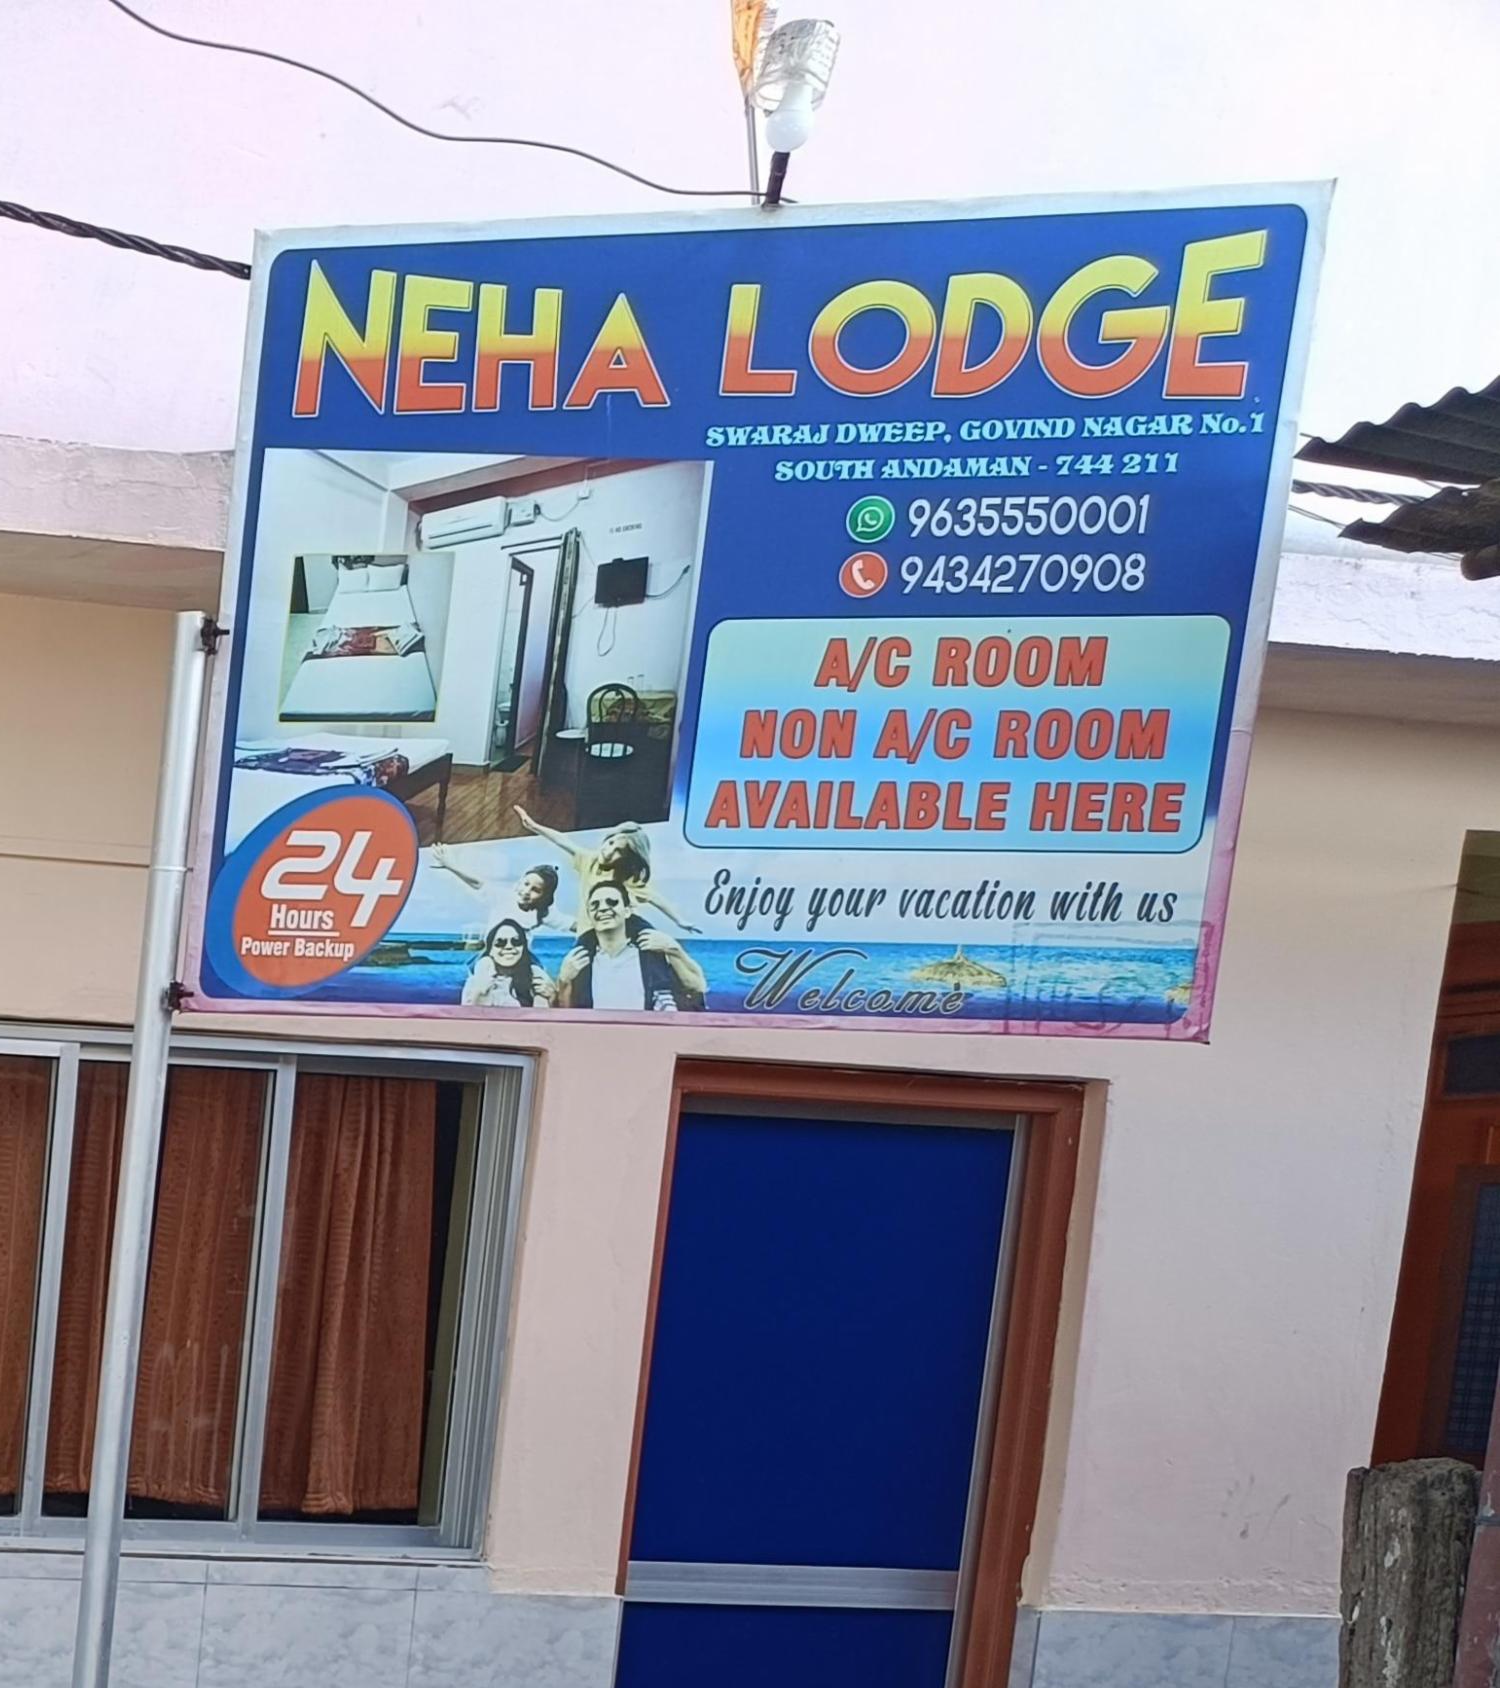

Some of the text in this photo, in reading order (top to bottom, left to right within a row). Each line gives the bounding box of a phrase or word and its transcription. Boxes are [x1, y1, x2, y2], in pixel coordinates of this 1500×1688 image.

[291, 229, 1268, 418] NEHA LODGE
[705, 411, 1266, 449] SWARAJ DWEEP, GOVIND NAGAR No.1
[773, 458, 875, 482] SOUTH
[880, 456, 1033, 479] ANDAMAN
[1056, 453, 1114, 476] 744
[1120, 451, 1180, 475] 211
[906, 493, 1151, 538] 9635550001
[899, 552, 1147, 596] 9434270908
[814, 636, 1109, 693] A/C ROOM
[739, 707, 1171, 764] NON A/C ROOM
[703, 780, 1186, 833] AVAILABLE HERE
[260, 829, 404, 928] 24
[705, 868, 1179, 933] Enjoy your vacation with us
[270, 903, 335, 930] Hours
[240, 936, 355, 962] Power Backup
[735, 947, 968, 1014] Welcome
